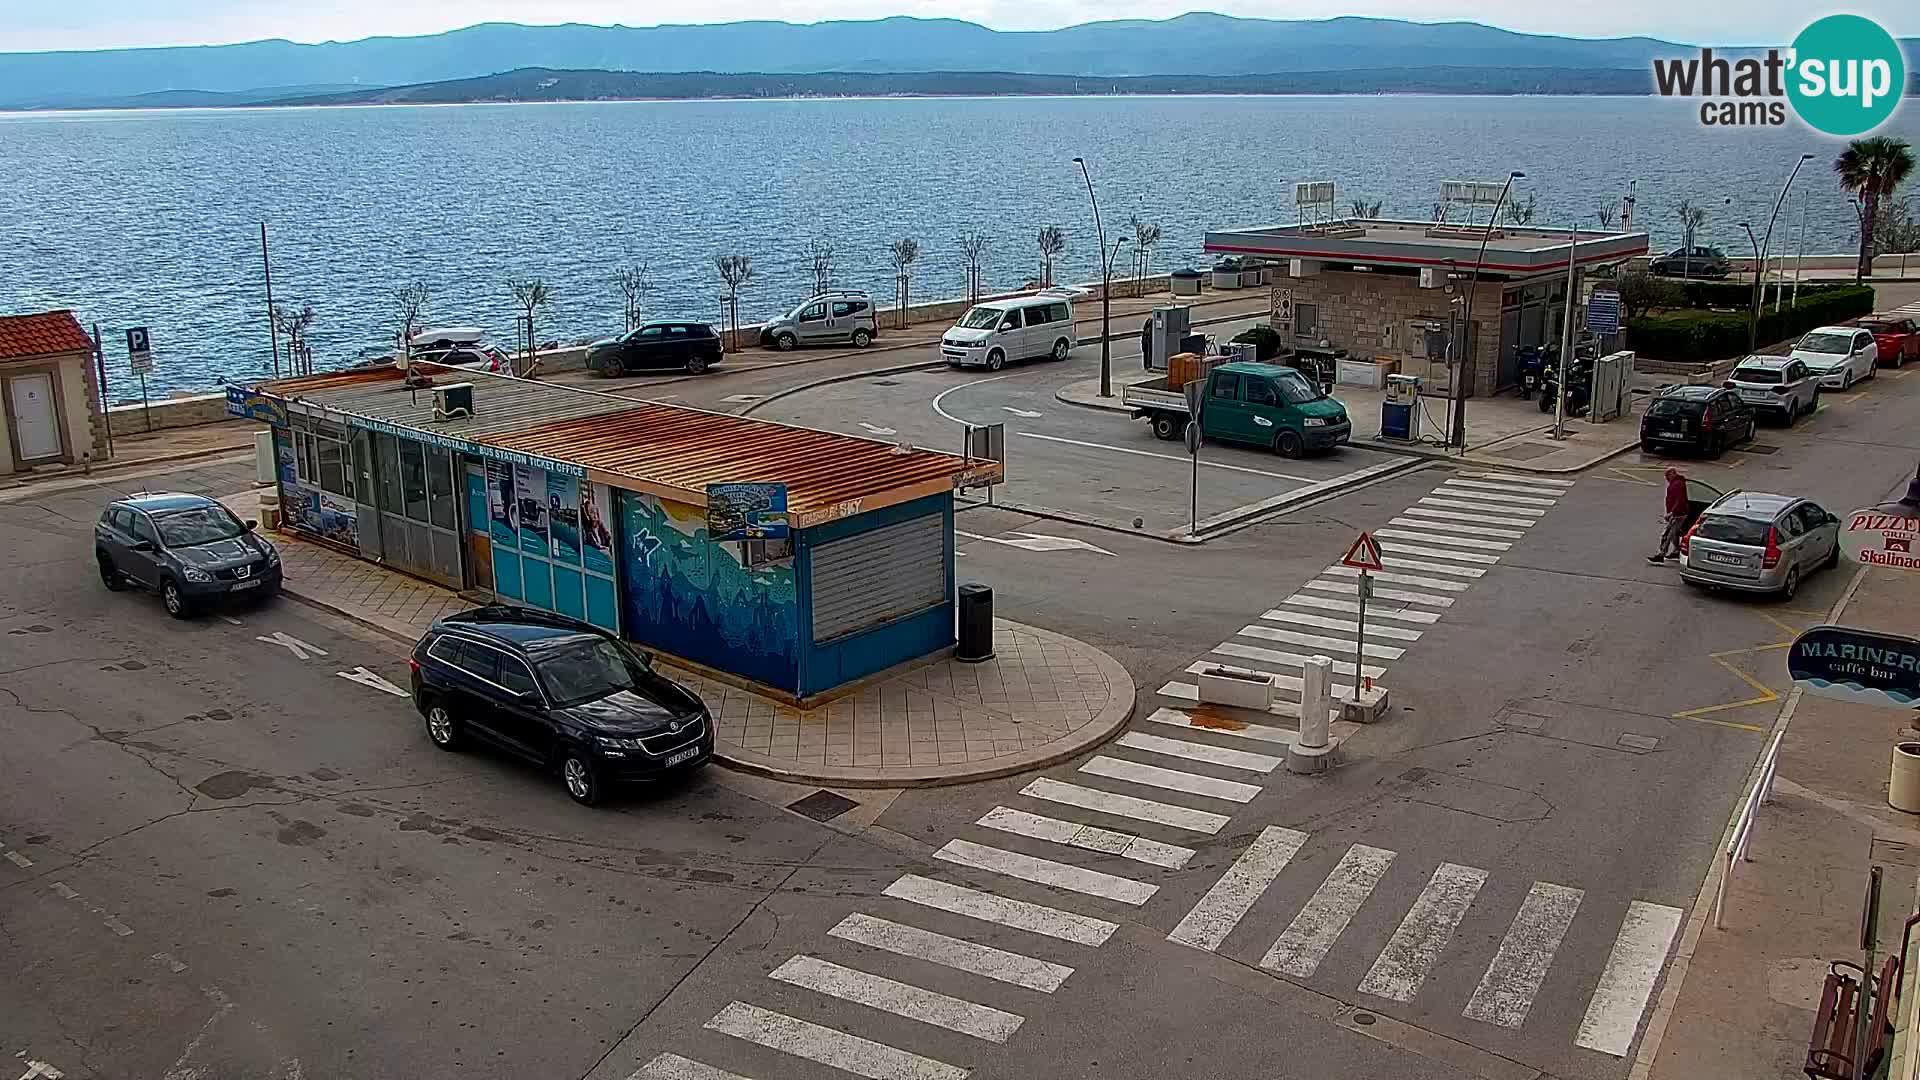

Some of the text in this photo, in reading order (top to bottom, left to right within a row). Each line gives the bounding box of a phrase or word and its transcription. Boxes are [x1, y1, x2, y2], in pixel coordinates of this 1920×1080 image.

[131, 331, 144, 349] P
[397, 427, 437, 444] AUTOBUSNA
[437, 437, 469, 451] POSTAJA
[480, 446, 494, 457] BUS
[495, 451, 527, 464] STATION
[529, 457, 555, 471] TICKET
[556, 462, 583, 477] OFFICE
[1848, 516, 1920, 533] PIZZE
[1882, 530, 1916, 540] GRILL
[1829, 662, 1897, 680] caffe bar
